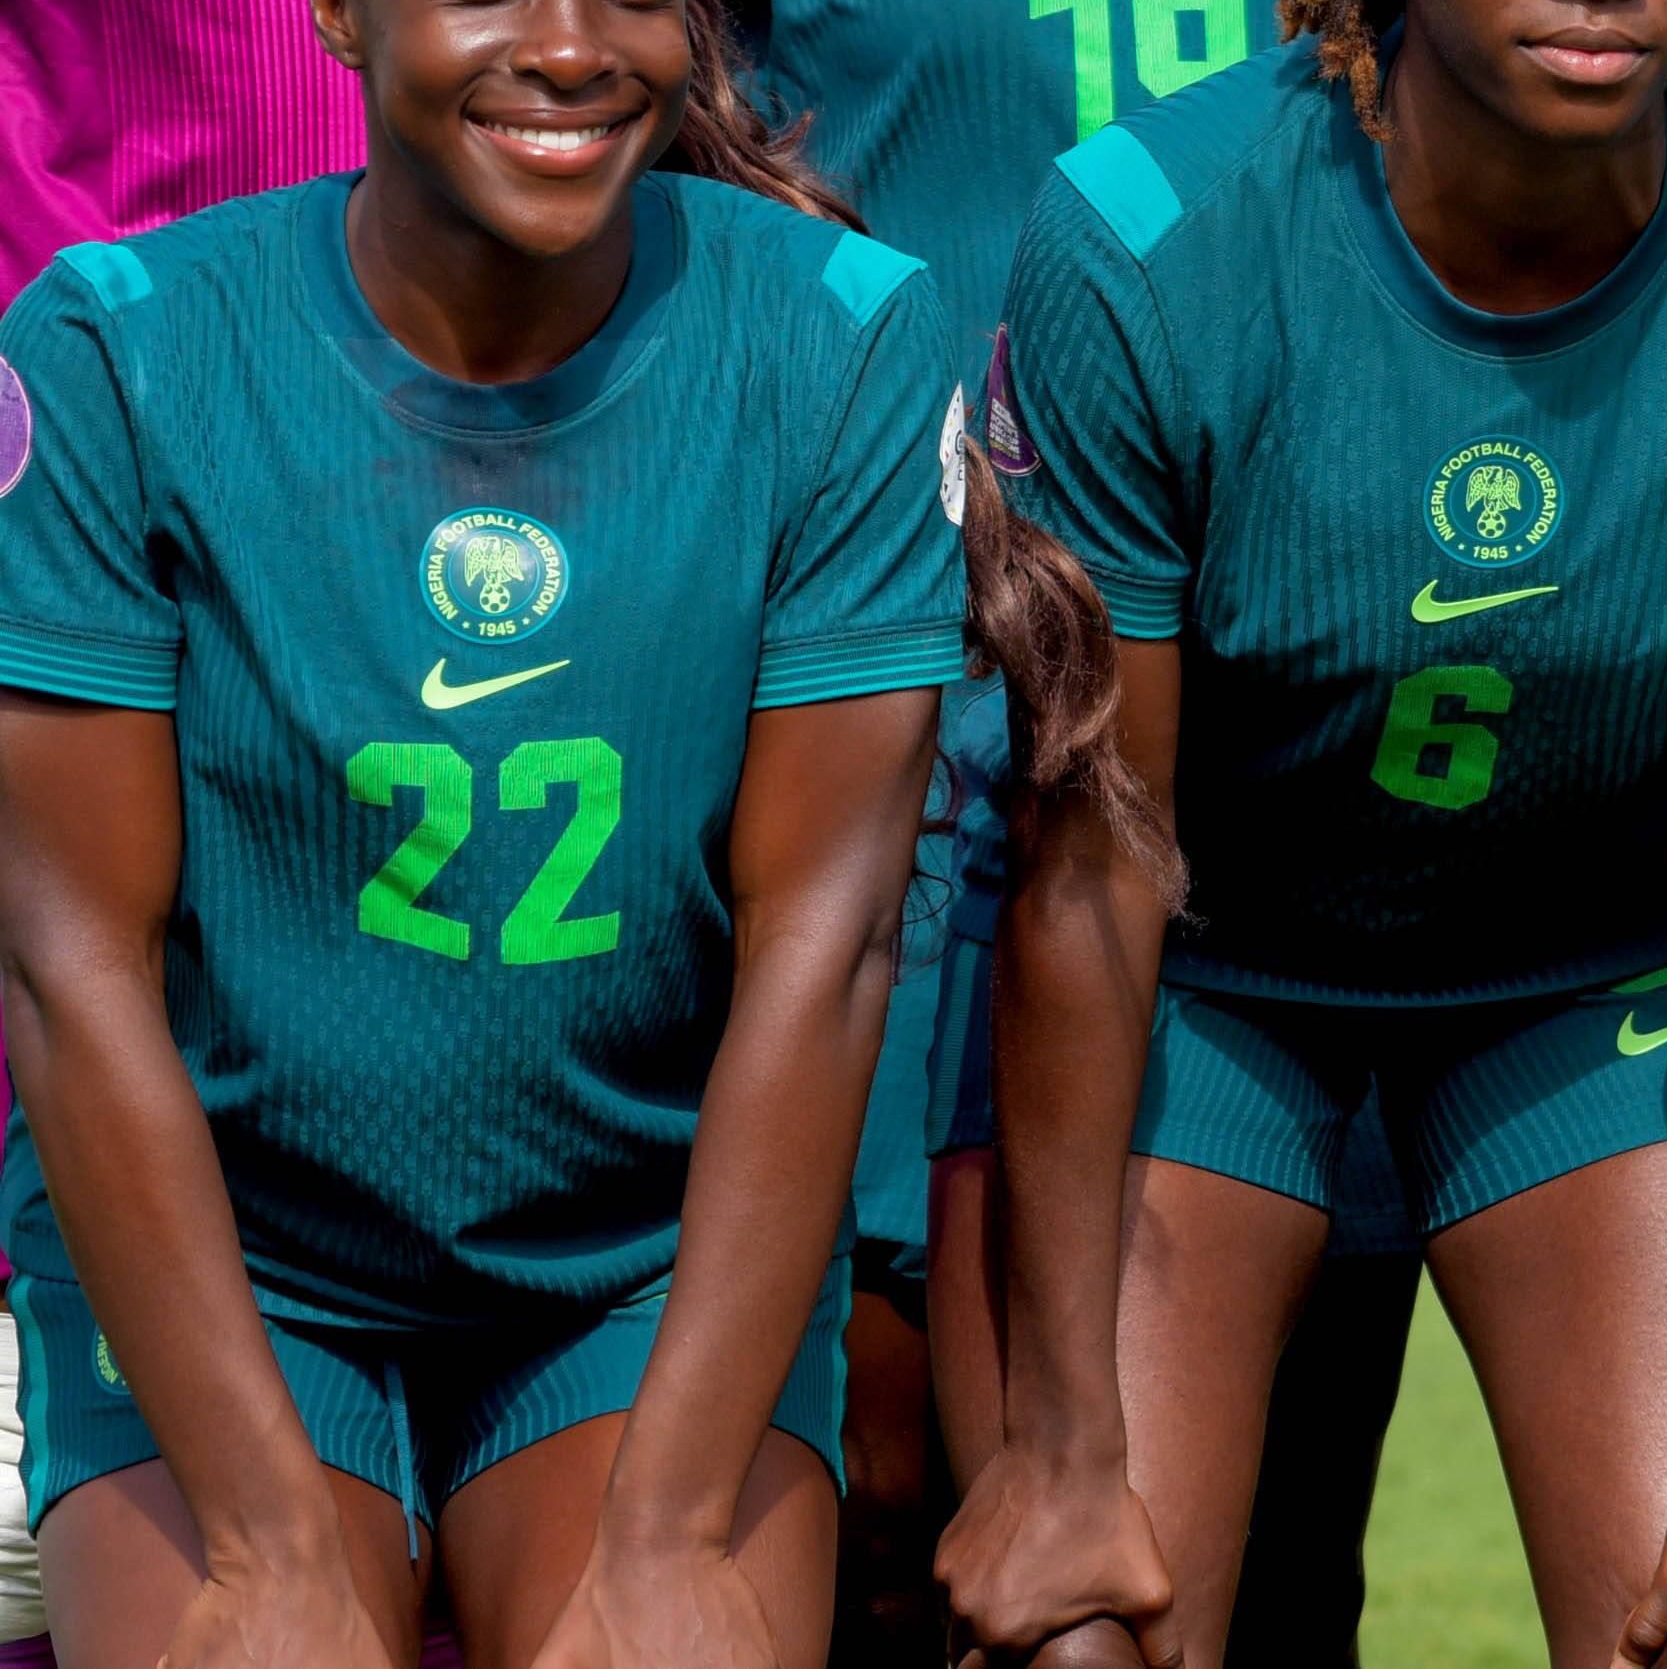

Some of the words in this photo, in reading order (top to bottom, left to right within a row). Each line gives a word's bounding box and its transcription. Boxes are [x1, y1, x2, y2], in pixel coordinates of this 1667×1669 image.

[1441, 442, 1521, 478] FOOTBALL
[1431, 480, 1456, 541] NIGERIA
[1523, 452, 1557, 544] FEDERATION
[435, 514, 517, 551] FOOTBALL
[1473, 545, 1509, 559] 1945
[428, 554, 458, 619] NIGERIA
[519, 523, 561, 616] FEDERATION
[478, 620, 517, 637] 1945
[1370, 665, 1513, 811] 6
[346, 736, 622, 965] 22
